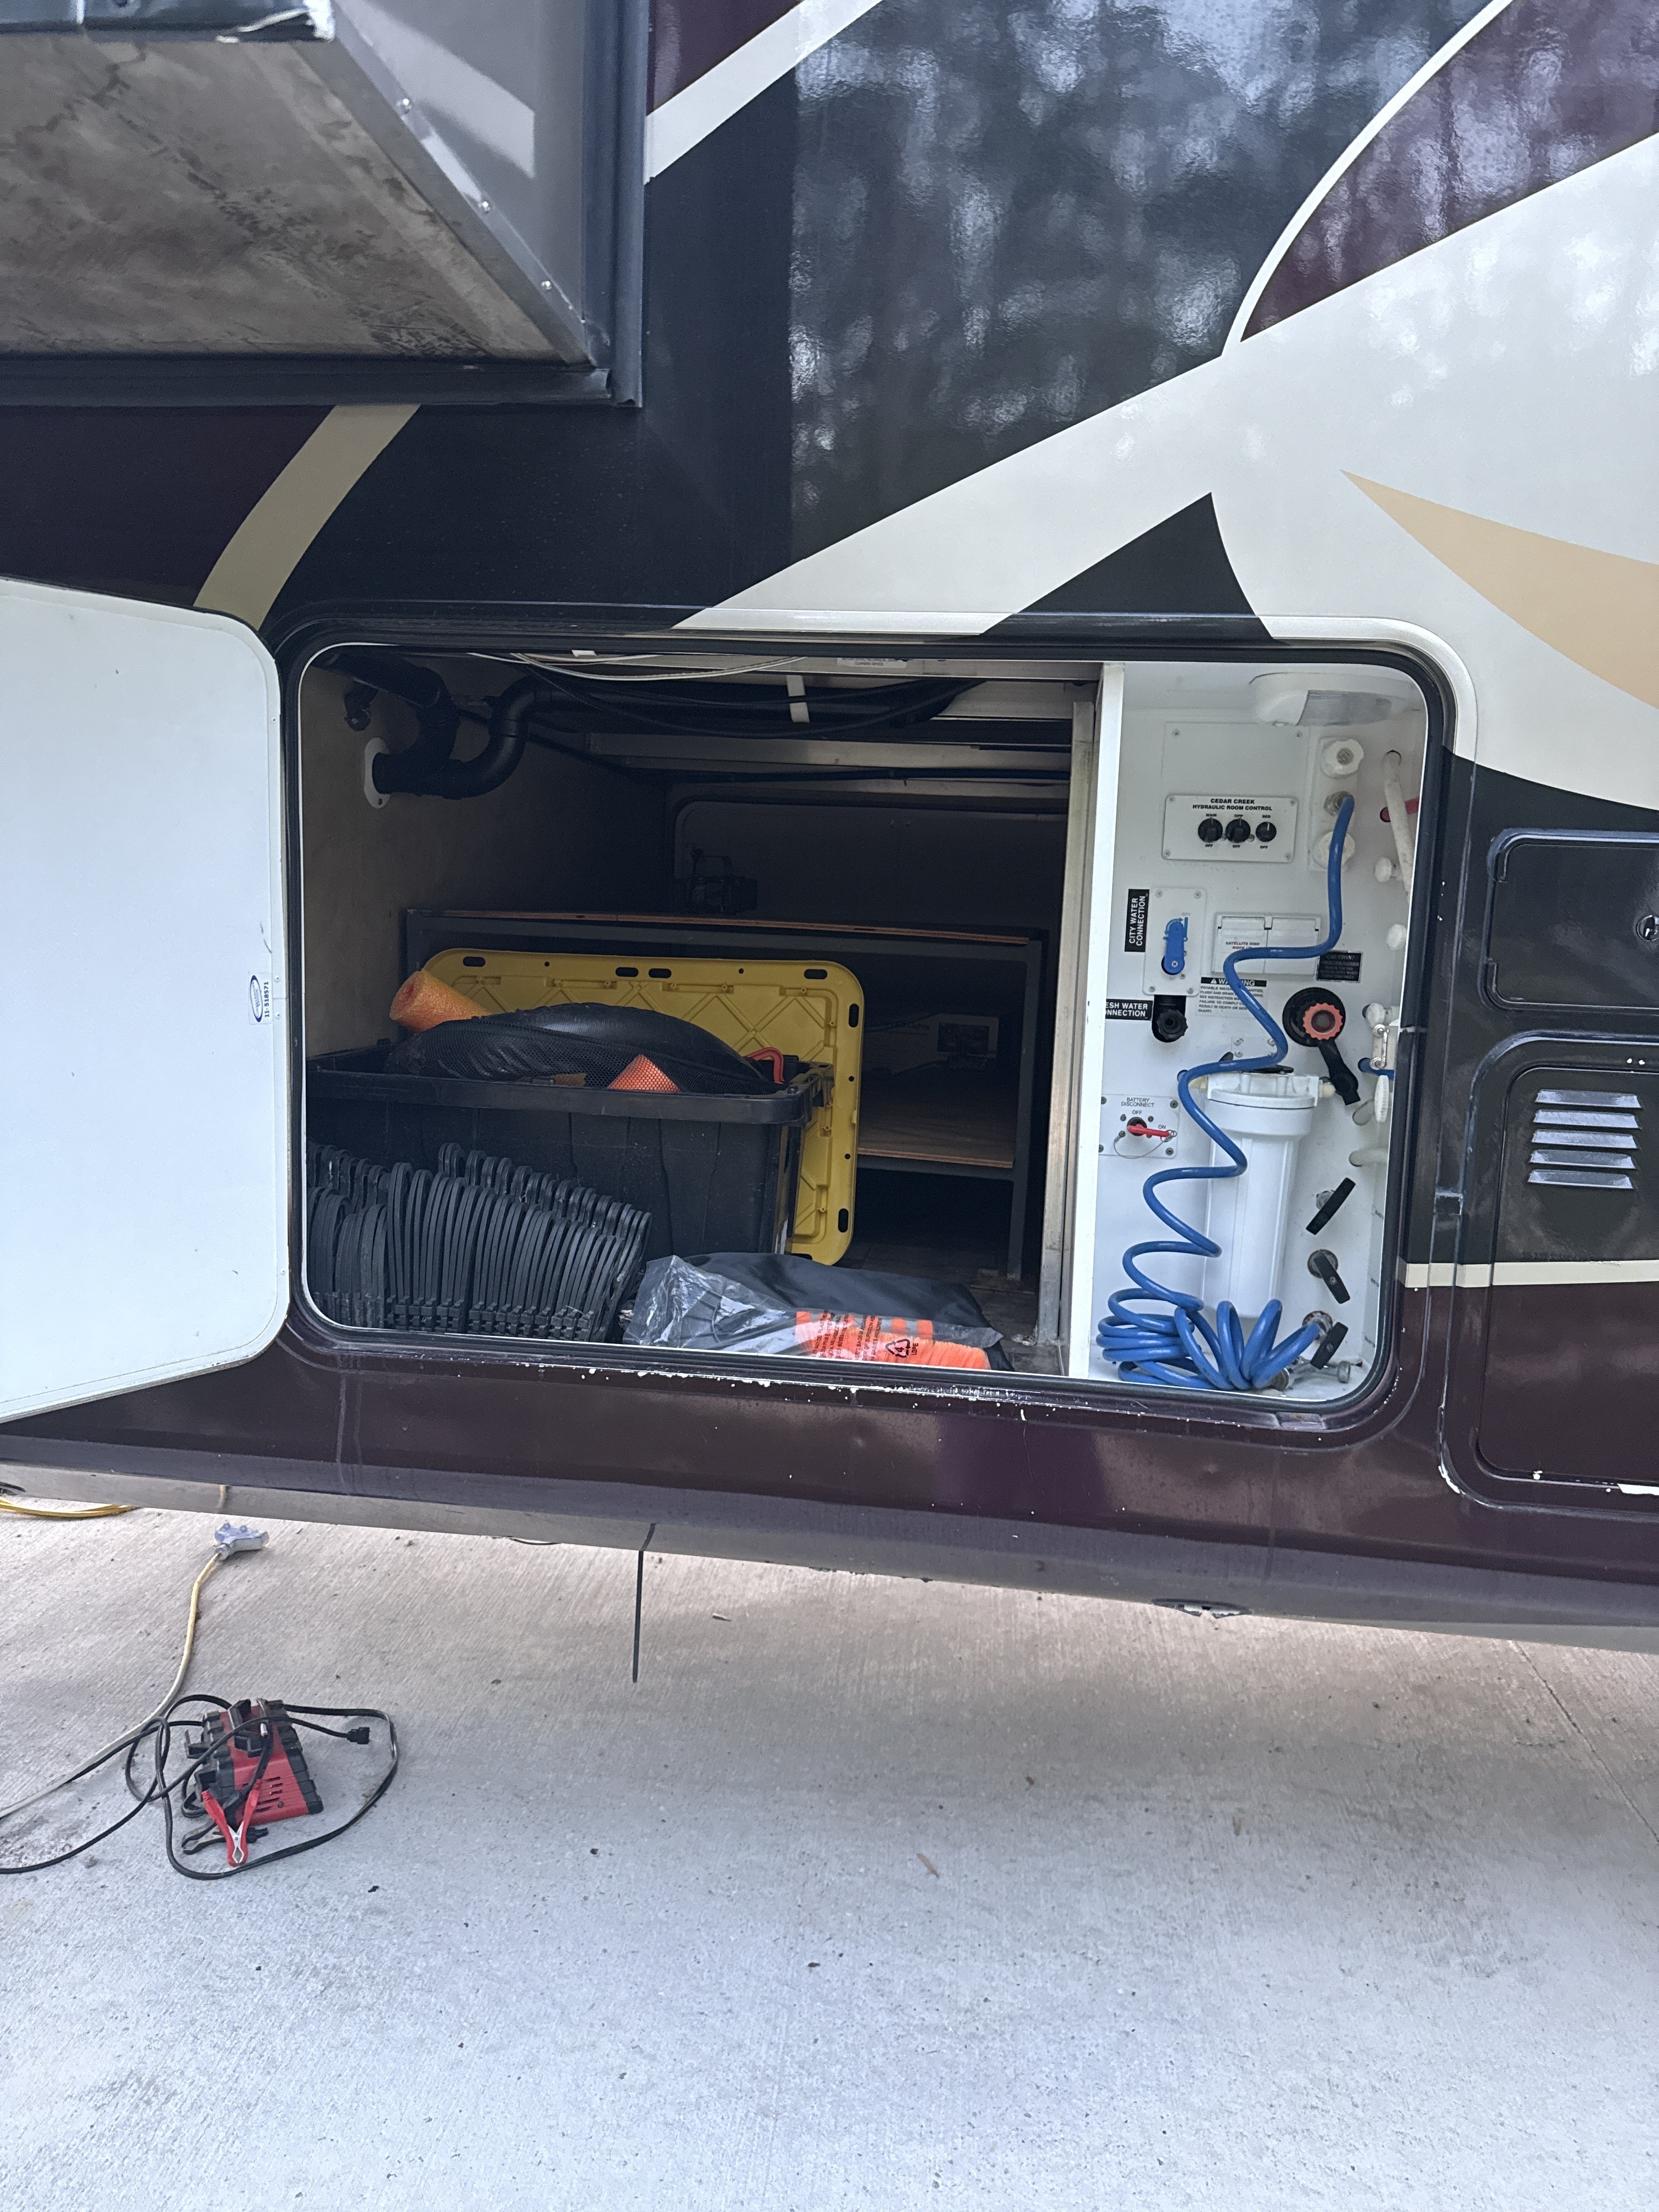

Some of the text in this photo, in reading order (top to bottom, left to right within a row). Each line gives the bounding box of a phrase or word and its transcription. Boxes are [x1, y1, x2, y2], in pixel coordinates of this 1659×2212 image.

[1130, 898, 1138, 924] WATER
[1136, 895, 1146, 946] CONNECTION
[1218, 978, 1255, 986] WAING
[1105, 1009, 1146, 1017] NNECTION
[911, 1342, 919, 1356] LDPE
